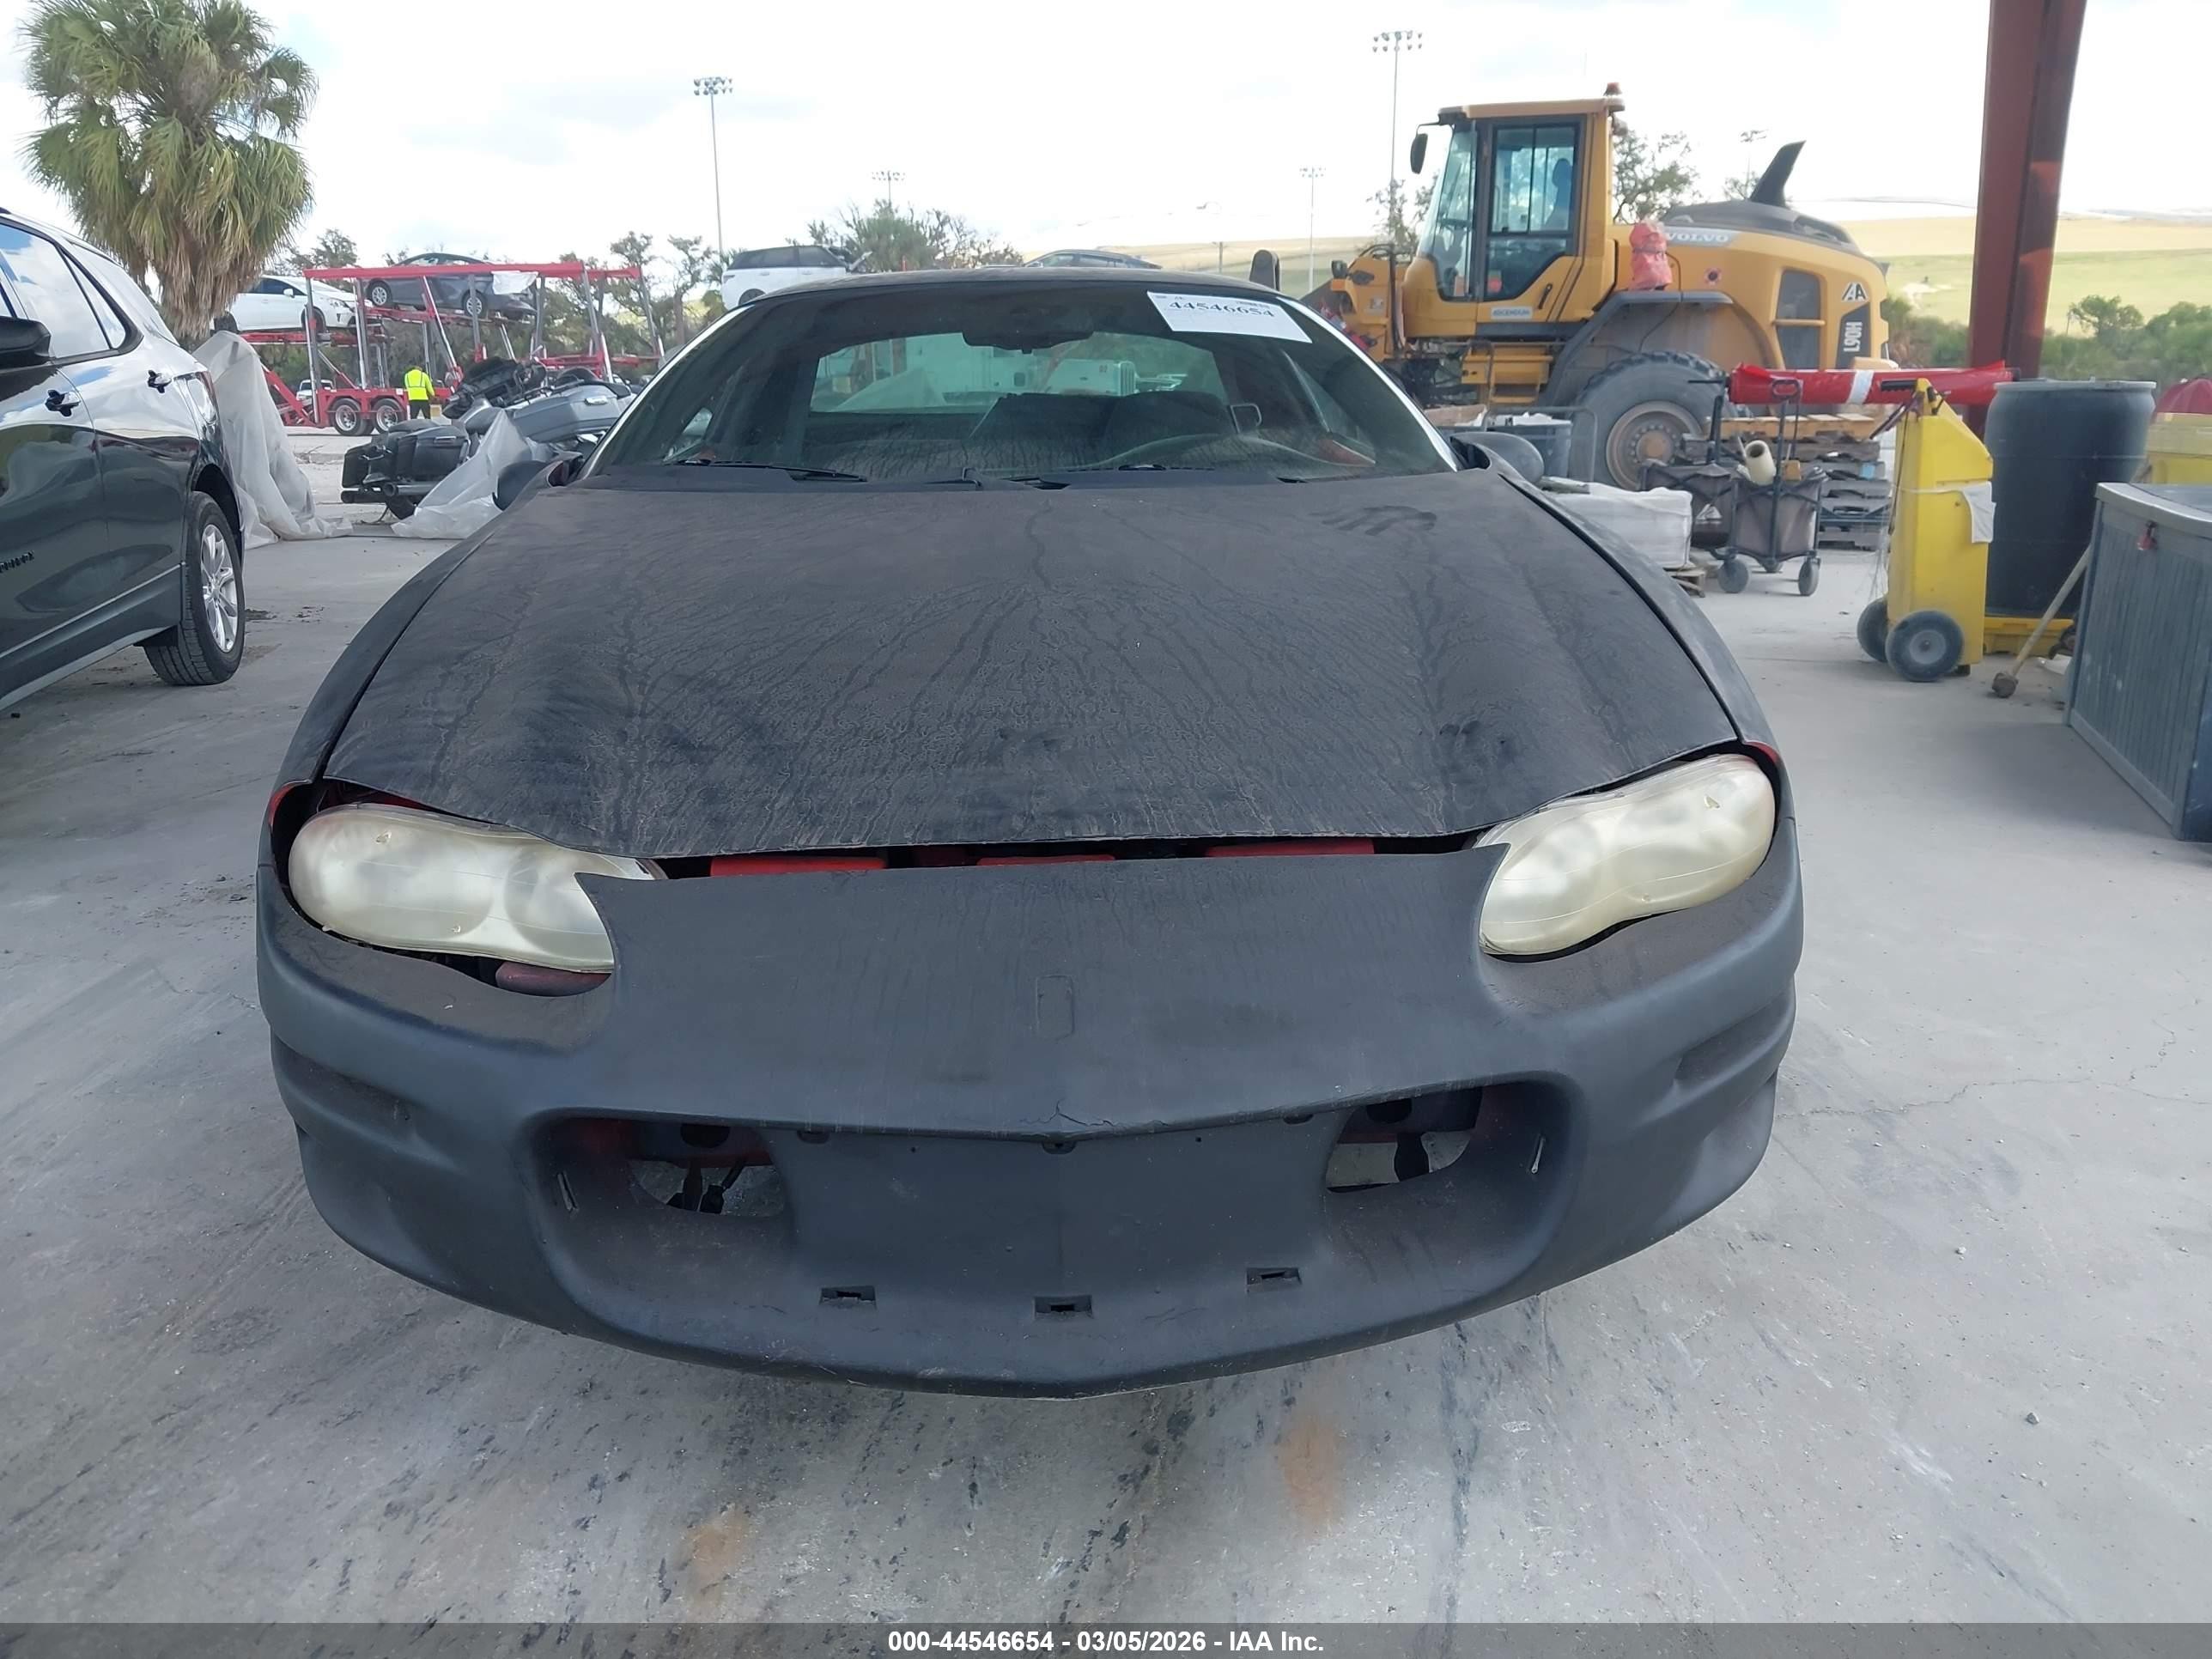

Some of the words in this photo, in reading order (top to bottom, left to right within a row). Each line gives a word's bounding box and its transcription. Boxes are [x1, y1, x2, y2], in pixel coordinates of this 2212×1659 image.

[1667, 233, 1729, 242] VOLVO
[1169, 301, 1275, 318] 44546654
[1844, 321, 1863, 352] L90H
